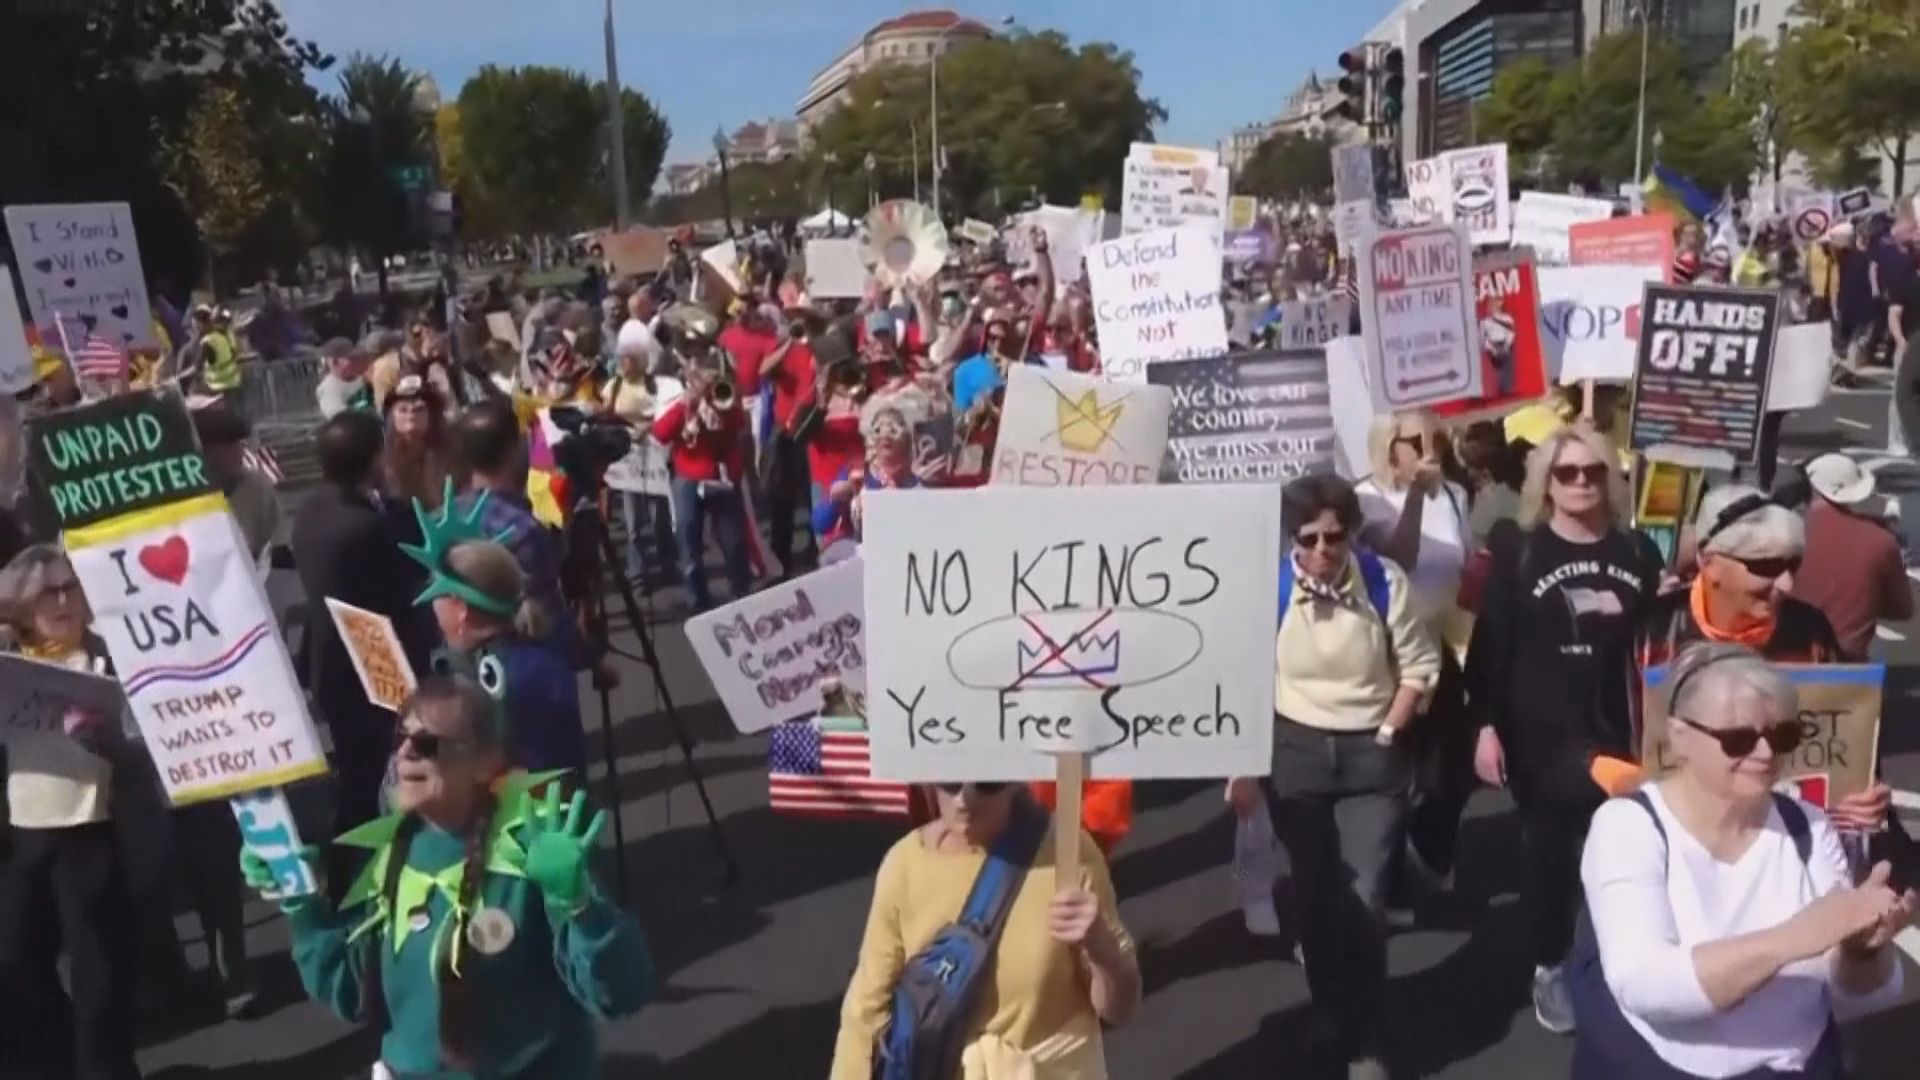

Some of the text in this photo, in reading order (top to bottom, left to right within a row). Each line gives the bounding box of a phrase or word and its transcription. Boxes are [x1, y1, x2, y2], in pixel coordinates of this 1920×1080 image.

[26, 211, 119, 243] I Stand
[1103, 232, 1177, 269] Defend
[1375, 248, 1402, 283] NO
[1475, 268, 1520, 301] AM
[1098, 290, 1220, 323] Constitution
[1653, 298, 1766, 331] HANDS
[1138, 320, 1176, 342] Not
[1650, 329, 1759, 376] OFF!
[1172, 384, 1207, 408] We
[1213, 380, 1258, 406] love
[42, 412, 163, 470] UNPAID
[1168, 436, 1315, 462] We miss our
[49, 454, 209, 519] PROTESTER
[1179, 459, 1311, 482] democracy.
[109, 549, 139, 596] I
[904, 536, 1220, 616] NO KINGS
[124, 596, 219, 652] USA
[152, 684, 245, 722] TRUMP
[886, 683, 1241, 754] Yes Free Speech
[159, 711, 276, 751] WANTS TO
[1797, 710, 1851, 739] ST
[167, 738, 295, 785] DESTROY IT
